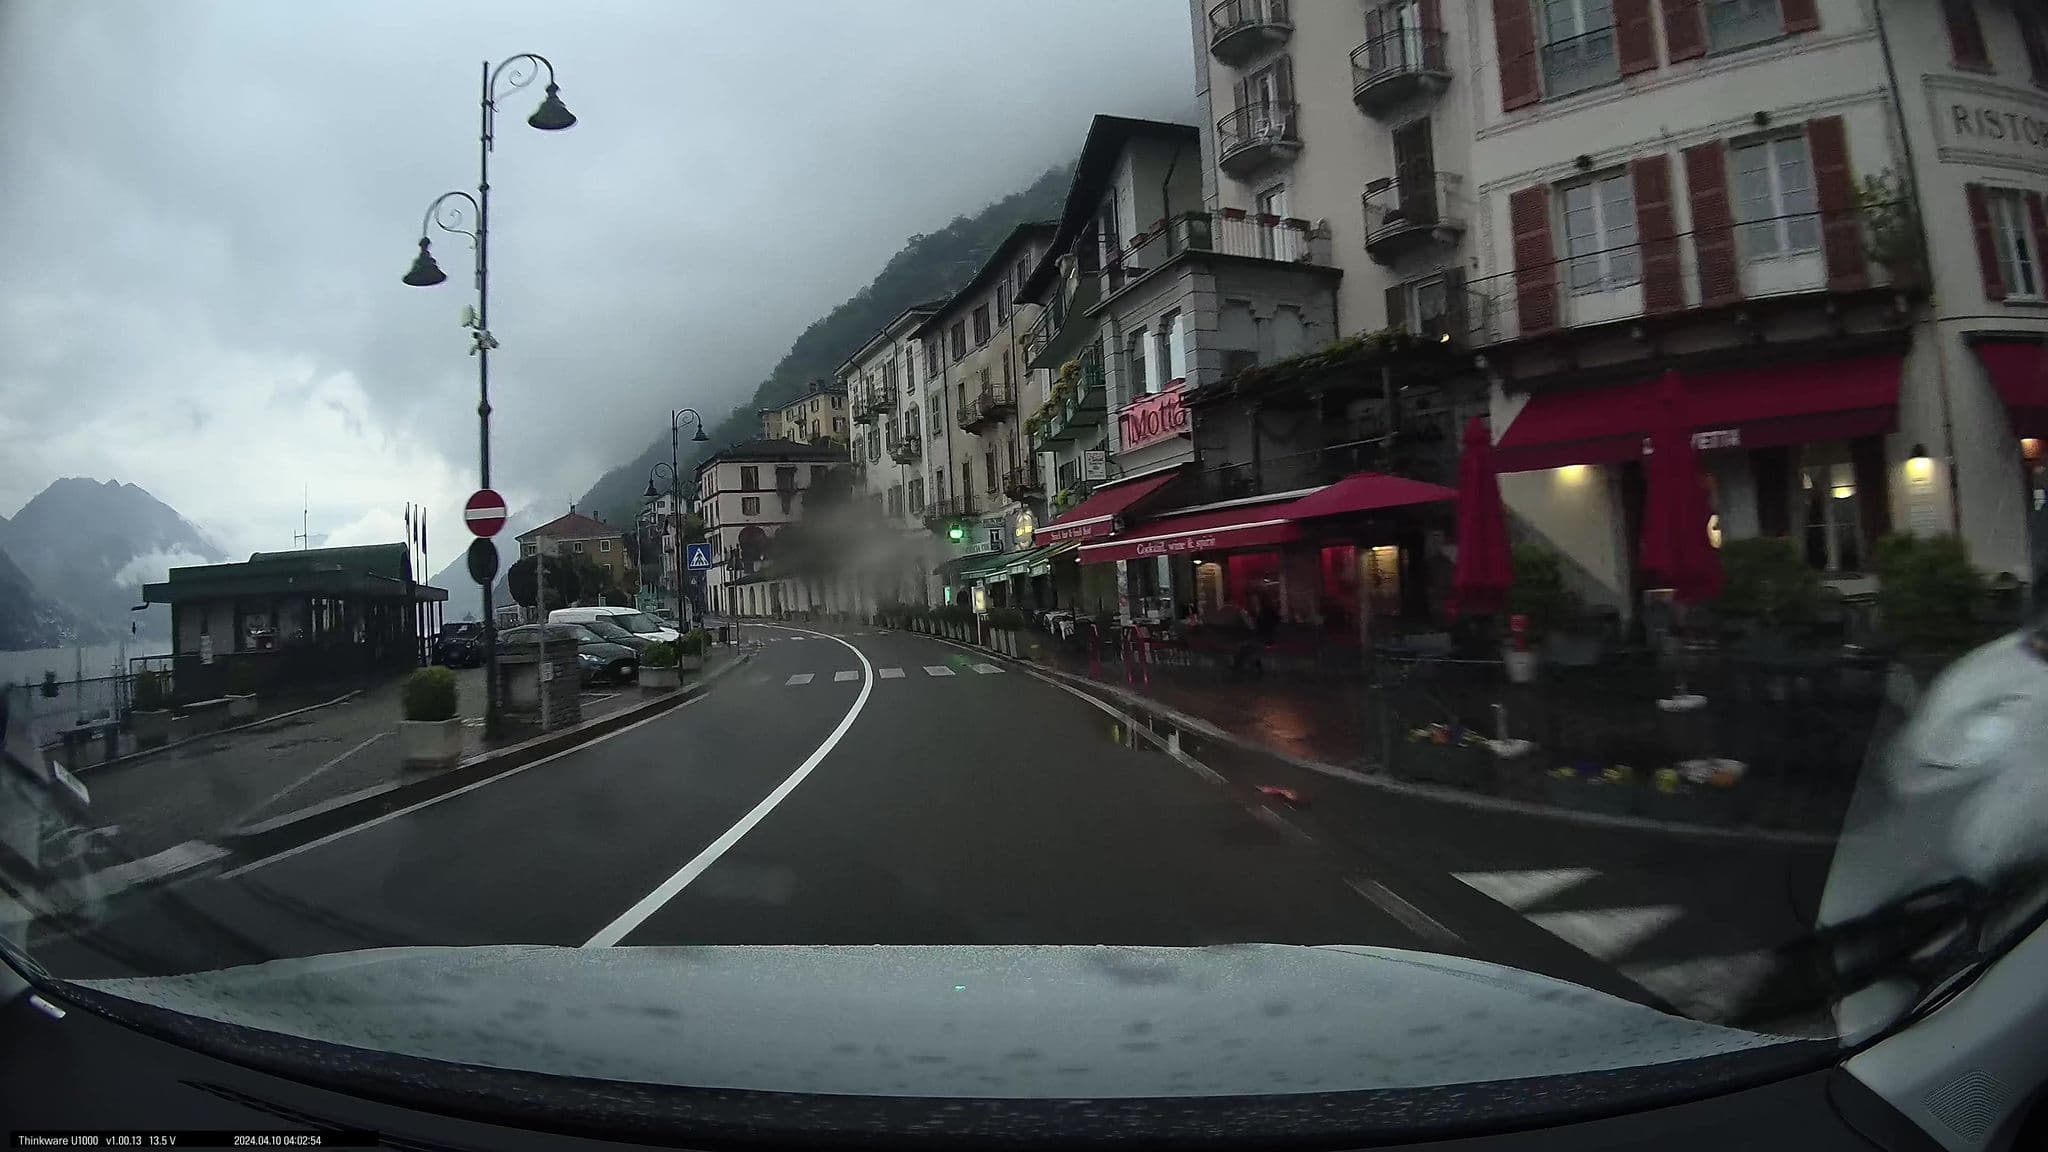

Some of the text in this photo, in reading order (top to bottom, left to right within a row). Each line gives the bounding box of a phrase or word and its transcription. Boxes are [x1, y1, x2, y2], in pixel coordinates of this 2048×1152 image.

[1119, 396, 1187, 448] Motta
[1168, 539, 1186, 550] wine
[1187, 537, 1195, 548] &
